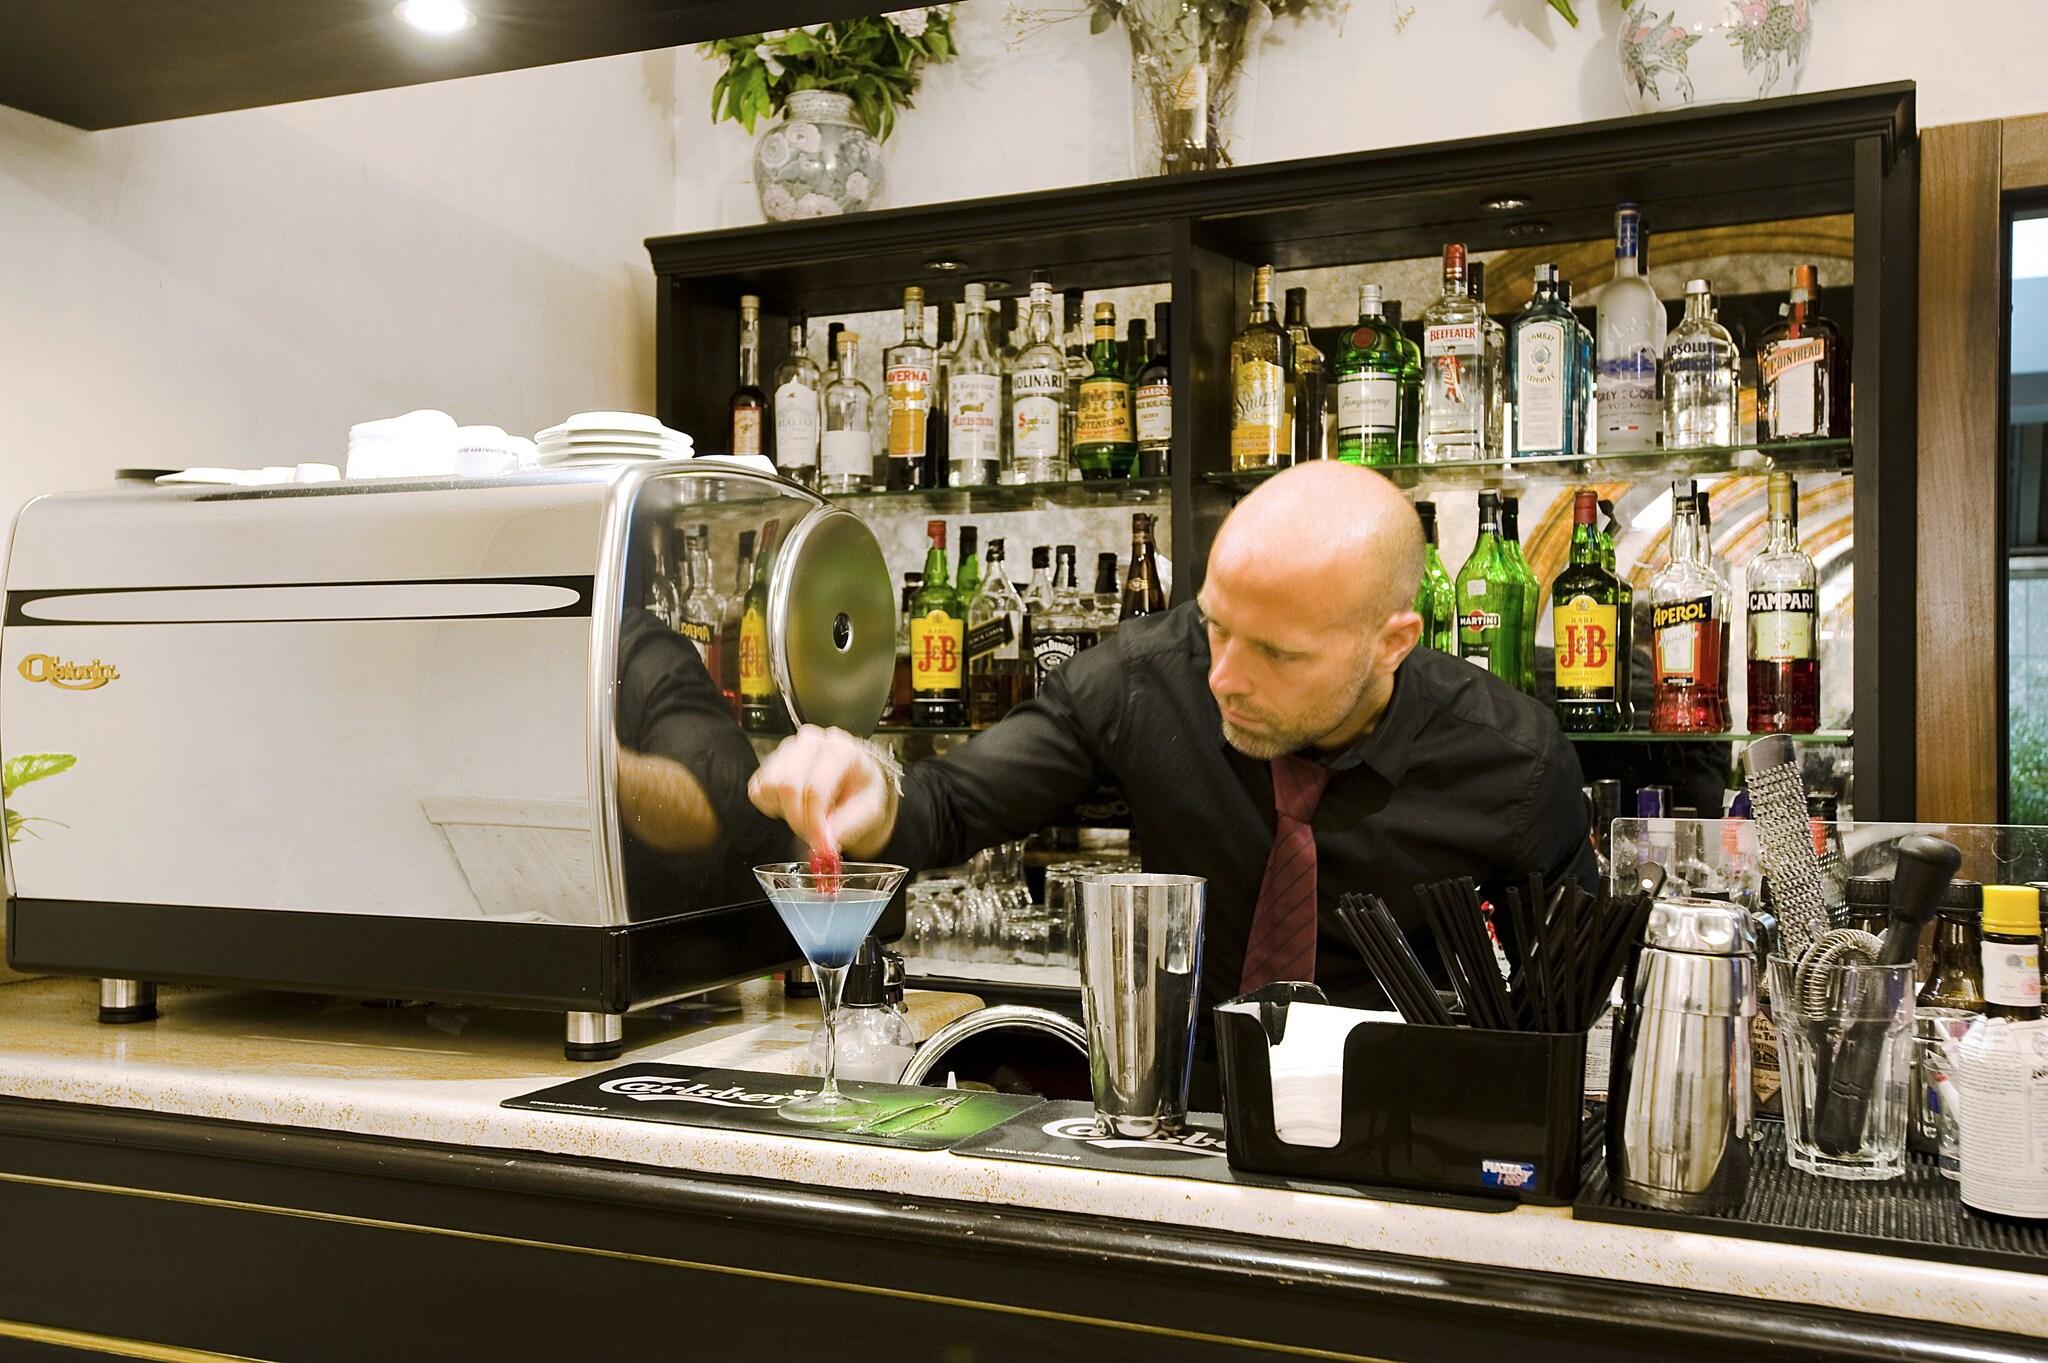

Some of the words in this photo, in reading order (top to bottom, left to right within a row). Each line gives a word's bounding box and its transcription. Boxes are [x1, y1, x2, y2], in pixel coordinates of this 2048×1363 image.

[1430, 327, 1476, 341] BEEFEATER
[1667, 341, 1713, 357] ABSOLUT
[1769, 342, 1821, 377] COINTREAU
[1750, 593, 1813, 611] CAMPARI
[1460, 616, 1498, 626] MARTINI
[1653, 602, 1706, 628] APEROL
[918, 635, 957, 672] J&B
[1560, 624, 1608, 668] J&B
